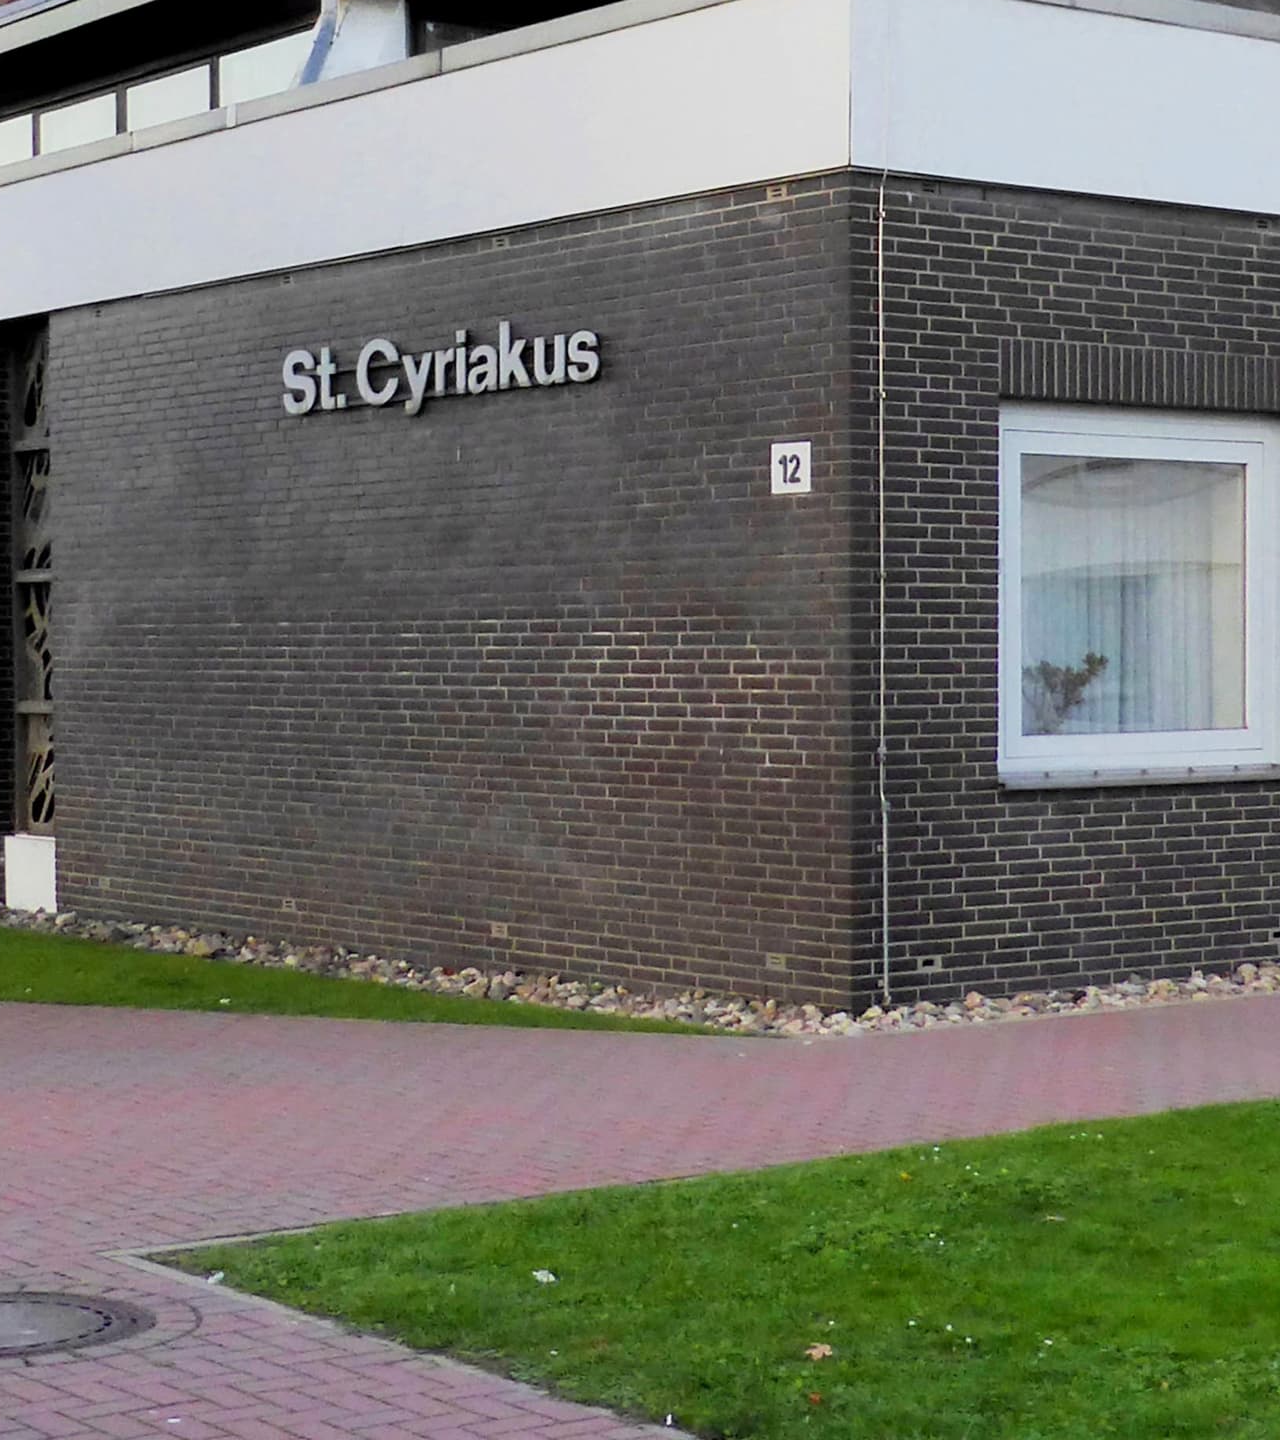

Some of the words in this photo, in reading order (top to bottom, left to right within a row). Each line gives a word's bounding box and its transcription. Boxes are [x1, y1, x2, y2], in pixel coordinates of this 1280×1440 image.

[282, 346, 347, 415] St.
[356, 320, 600, 415] Cyriakus
[778, 453, 802, 484] 12
